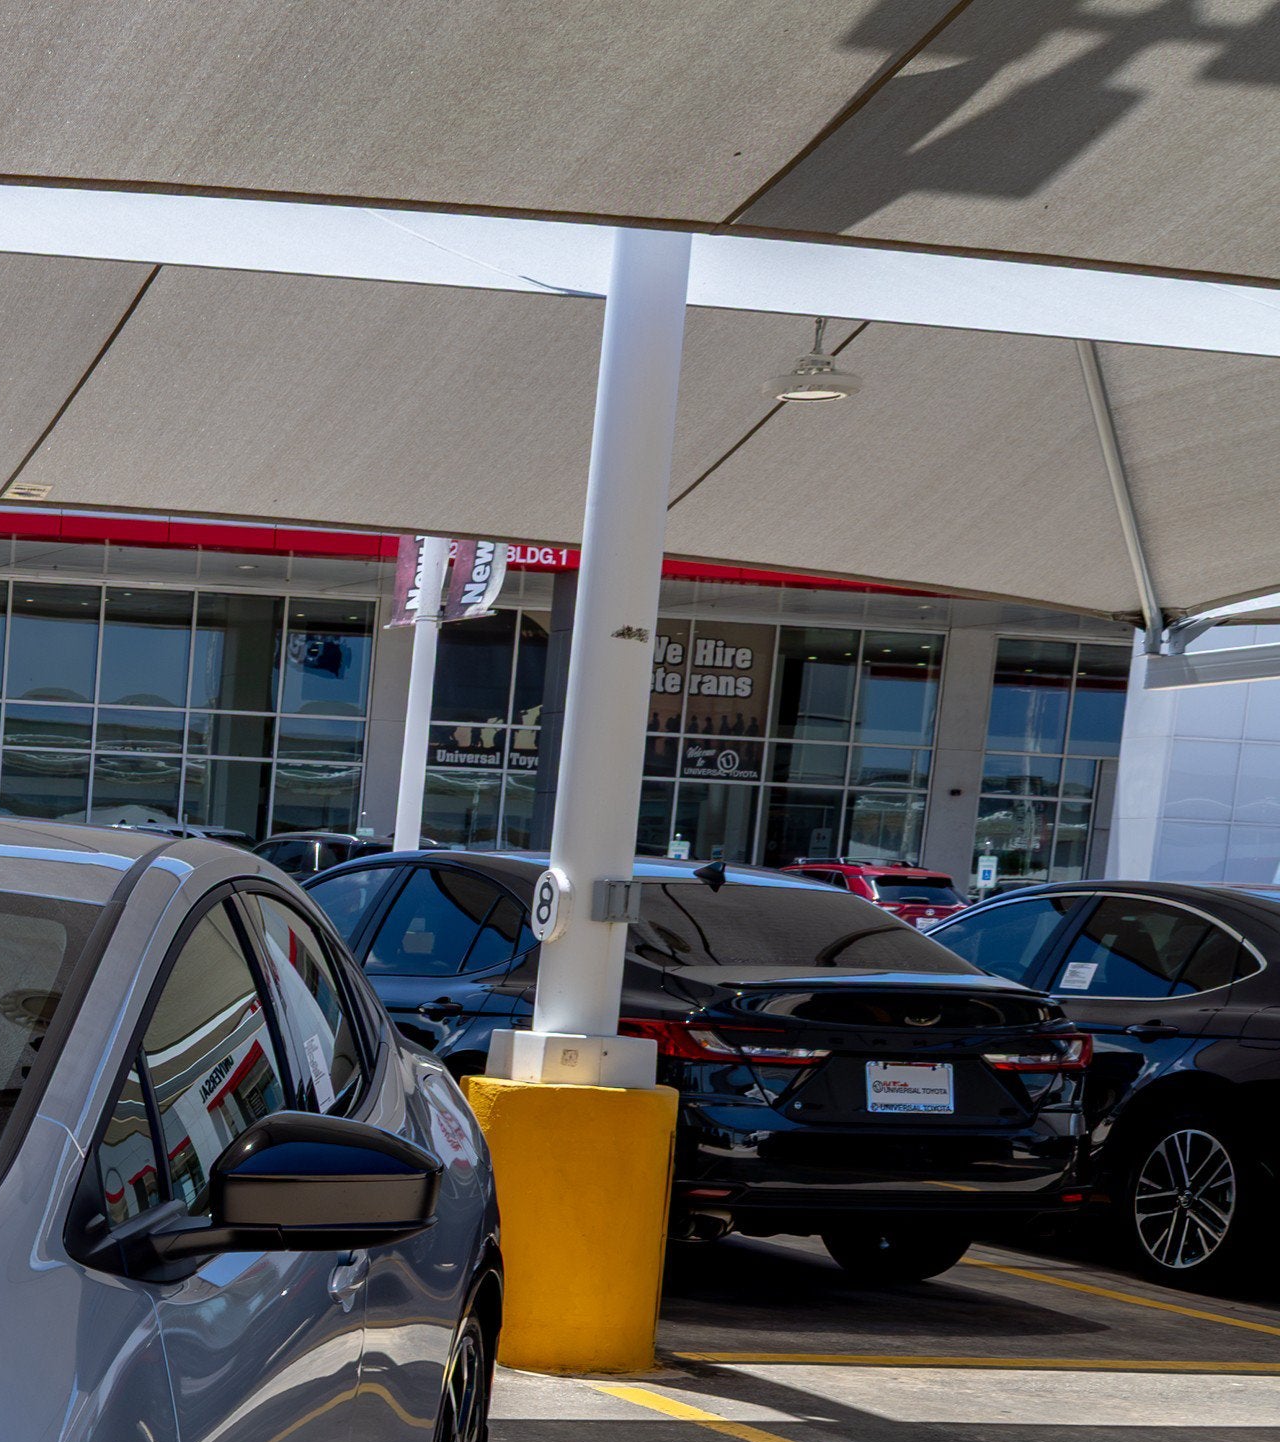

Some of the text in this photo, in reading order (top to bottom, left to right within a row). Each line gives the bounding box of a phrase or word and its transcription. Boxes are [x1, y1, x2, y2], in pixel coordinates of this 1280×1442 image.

[461, 541, 495, 604] New
[694, 638, 752, 669] Hire
[436, 749, 501, 764] Universal
[683, 767, 727, 776] UNIVERSAL
[536, 882, 553, 925] 8
